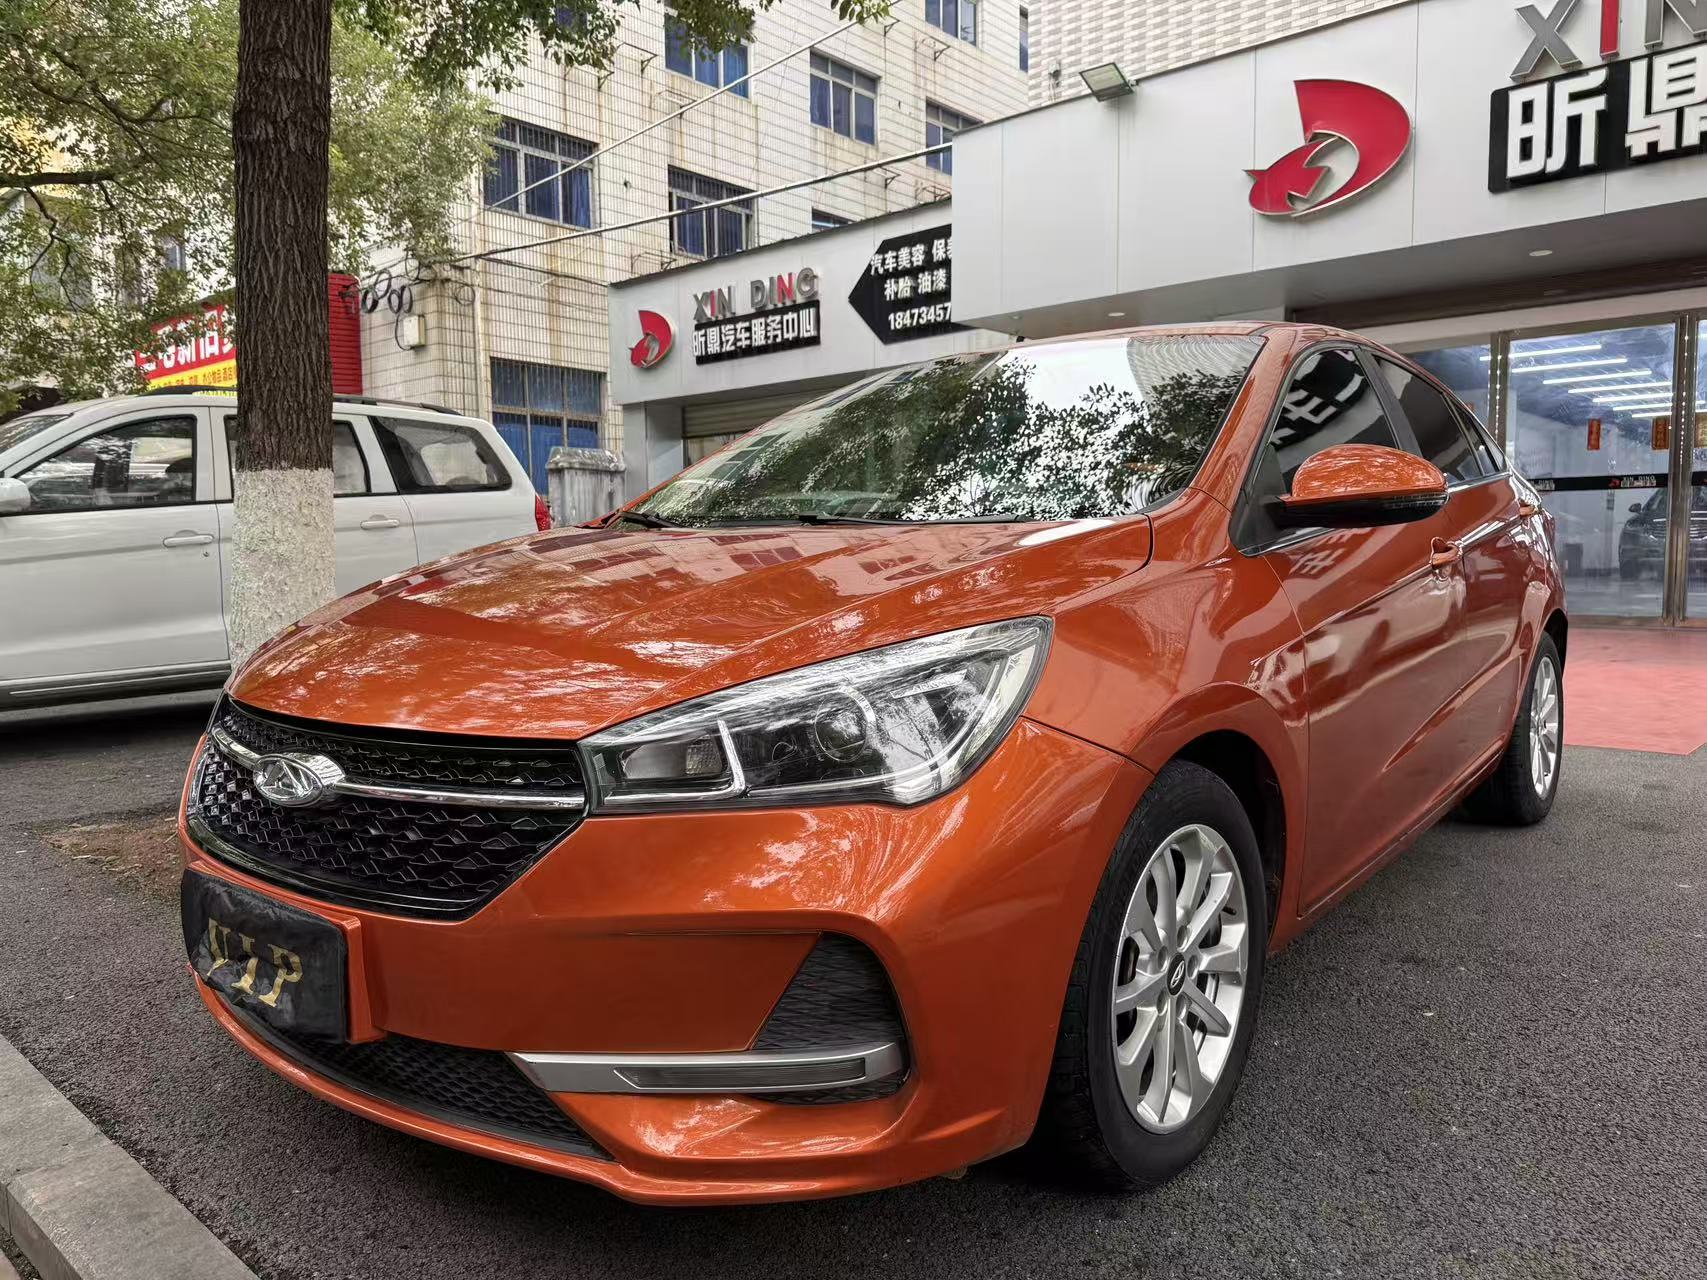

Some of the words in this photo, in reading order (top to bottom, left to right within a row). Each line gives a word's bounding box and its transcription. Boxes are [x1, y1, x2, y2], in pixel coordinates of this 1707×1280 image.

[1509, 0, 1707, 82] XIN
[870, 243, 926, 276] 汽车美容
[693, 285, 736, 323] XIN
[750, 267, 819, 310] DING
[884, 276, 914, 301] 补胎
[918, 268, 948, 294] 油漆
[693, 307, 816, 356] 昕鼎汽车服务中心
[888, 302, 952, 330] 18473457
[207, 917, 304, 1008] VIP
